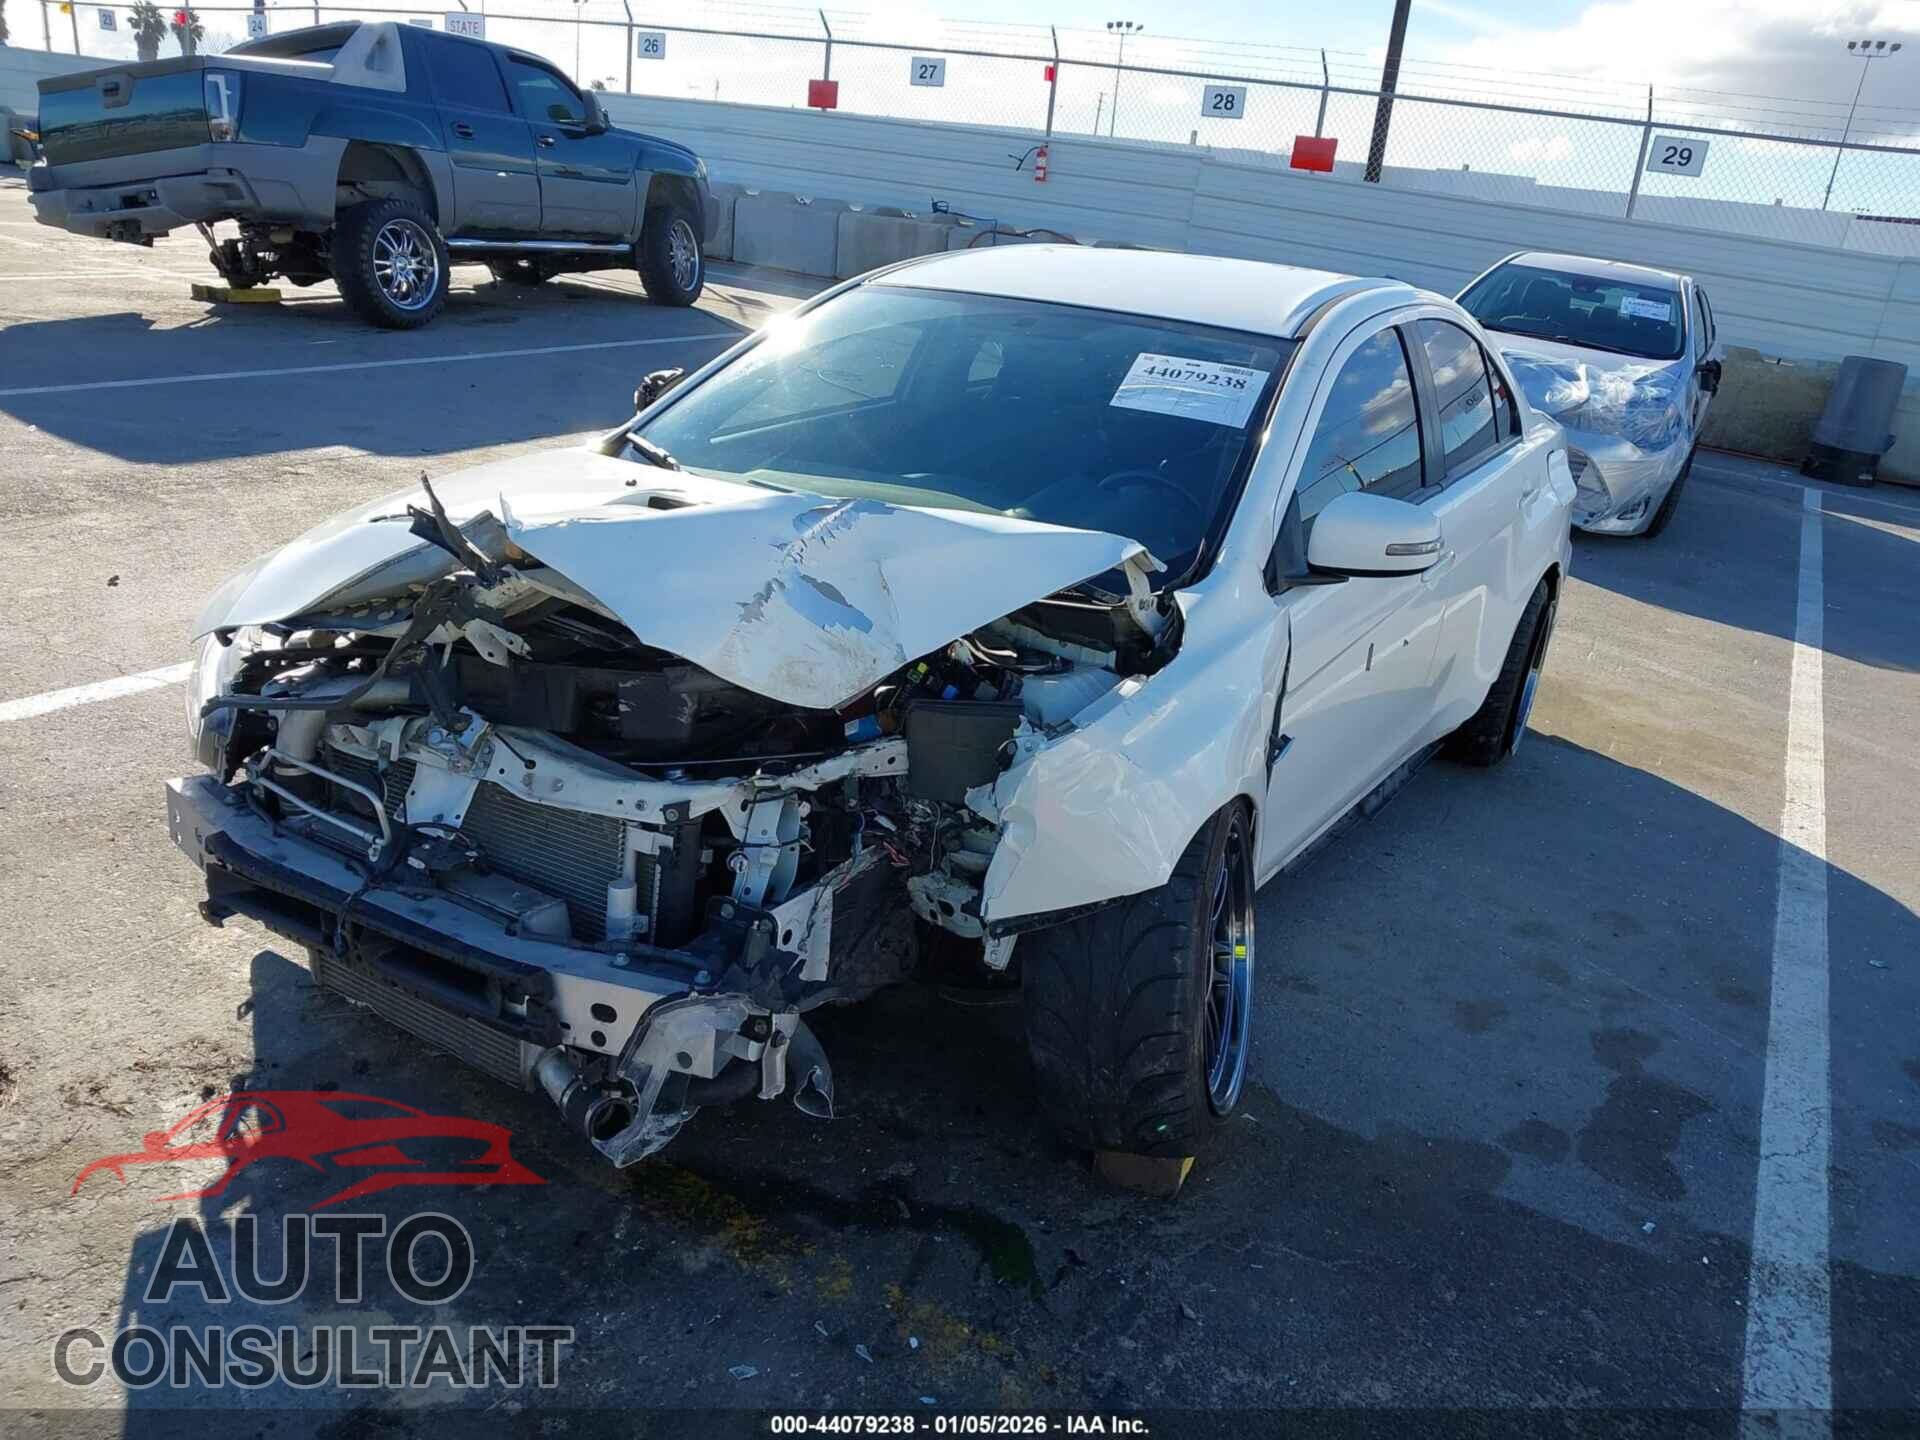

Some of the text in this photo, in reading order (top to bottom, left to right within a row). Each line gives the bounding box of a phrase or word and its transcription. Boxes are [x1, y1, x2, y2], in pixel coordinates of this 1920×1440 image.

[251, 20, 263, 32] 24
[449, 20, 480, 35] STATE
[644, 38, 659, 53] 26
[919, 64, 938, 79] 27
[1212, 93, 1235, 110] 28
[1662, 146, 1693, 166] 29
[1142, 364, 1248, 391] 44079238
